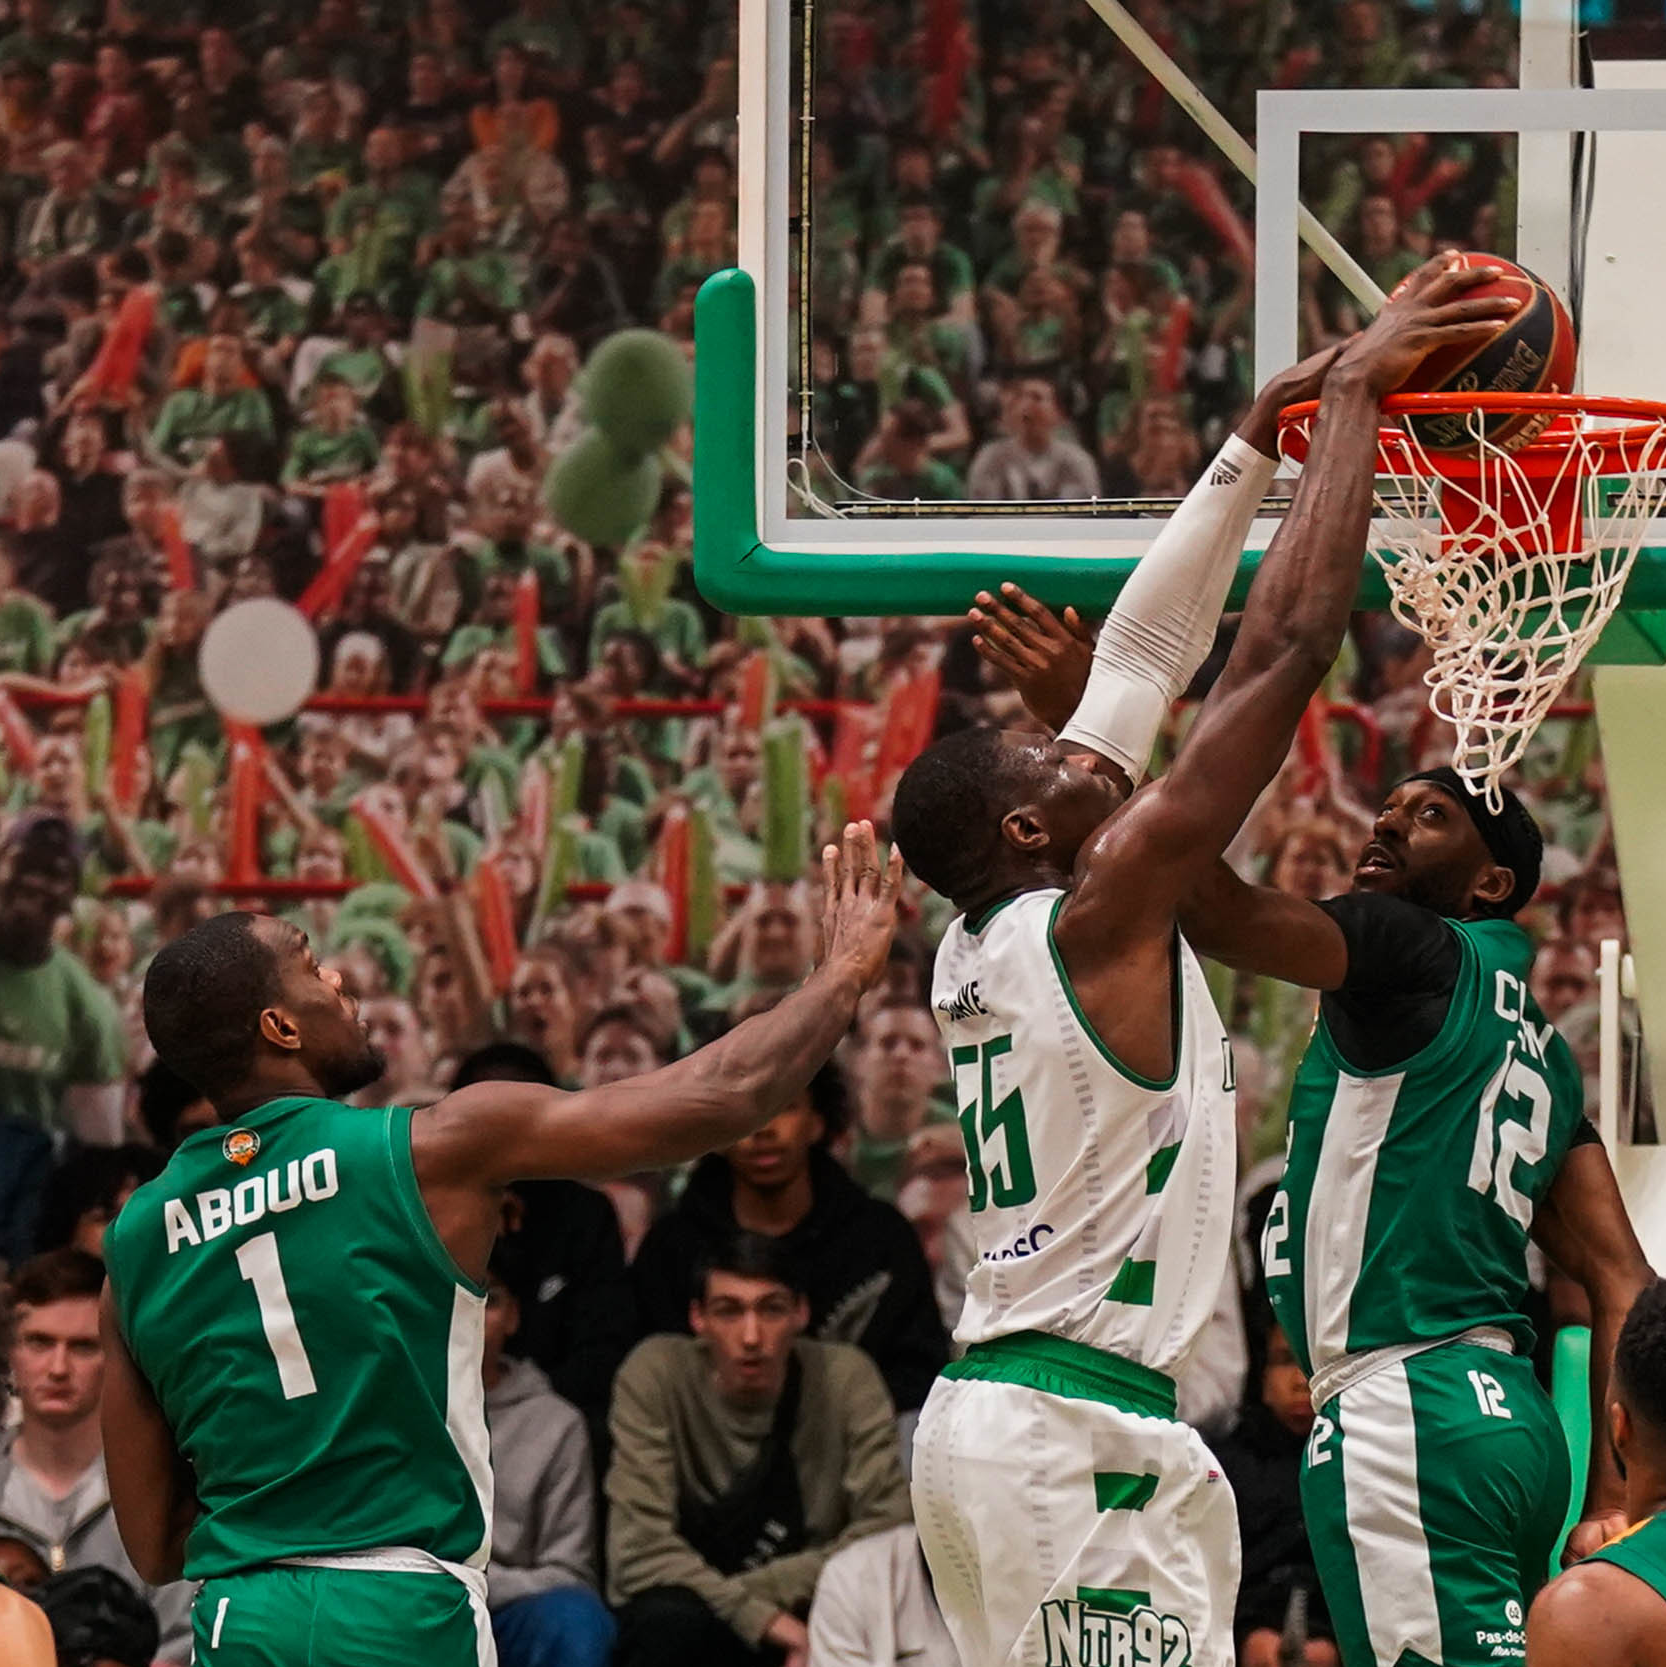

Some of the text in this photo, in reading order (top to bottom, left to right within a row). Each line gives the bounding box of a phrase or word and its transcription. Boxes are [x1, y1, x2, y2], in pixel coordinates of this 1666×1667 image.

[164, 1148, 339, 1255] ABOUO
[1467, 1040, 1552, 1232] 12
[234, 1231, 318, 1401] 1
[1466, 1369, 1513, 1420] 12
